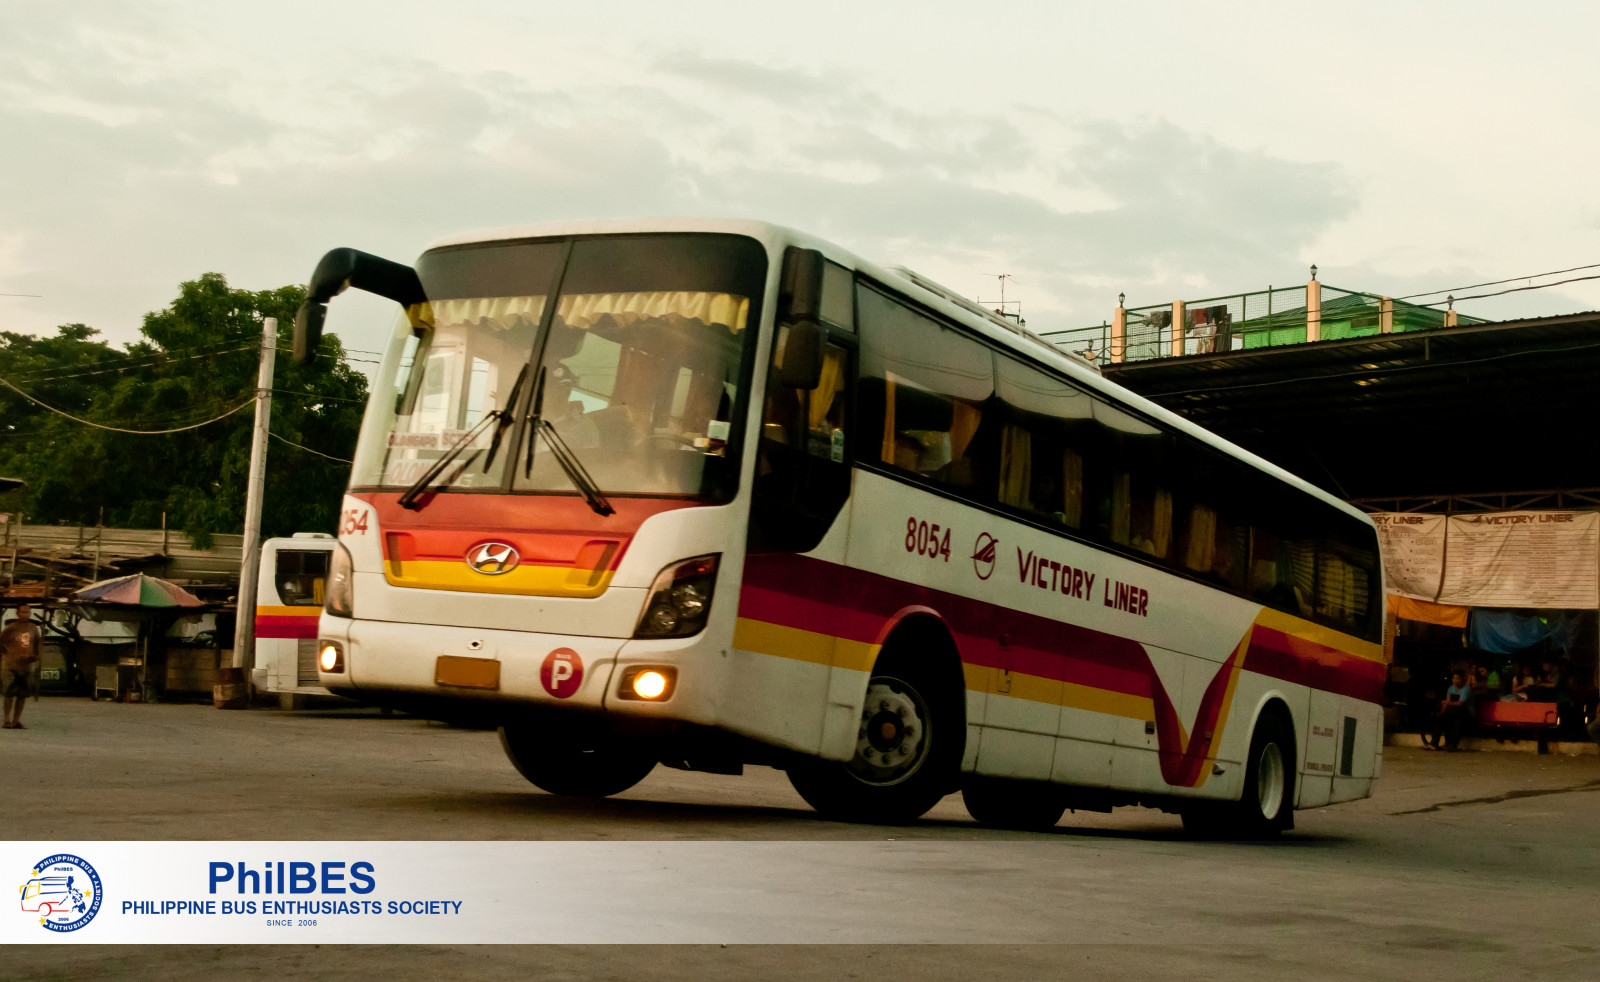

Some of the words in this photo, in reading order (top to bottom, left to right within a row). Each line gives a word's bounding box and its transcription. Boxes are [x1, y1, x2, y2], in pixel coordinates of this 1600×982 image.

[1392, 516, 1424, 525] LINER
[1485, 515, 1536, 525] VICTORY
[1539, 513, 1574, 523] LINER
[904, 516, 951, 563] 8054
[1016, 545, 1096, 602] VICTORY
[1103, 577, 1149, 618] LINER
[551, 659, 574, 690] P
